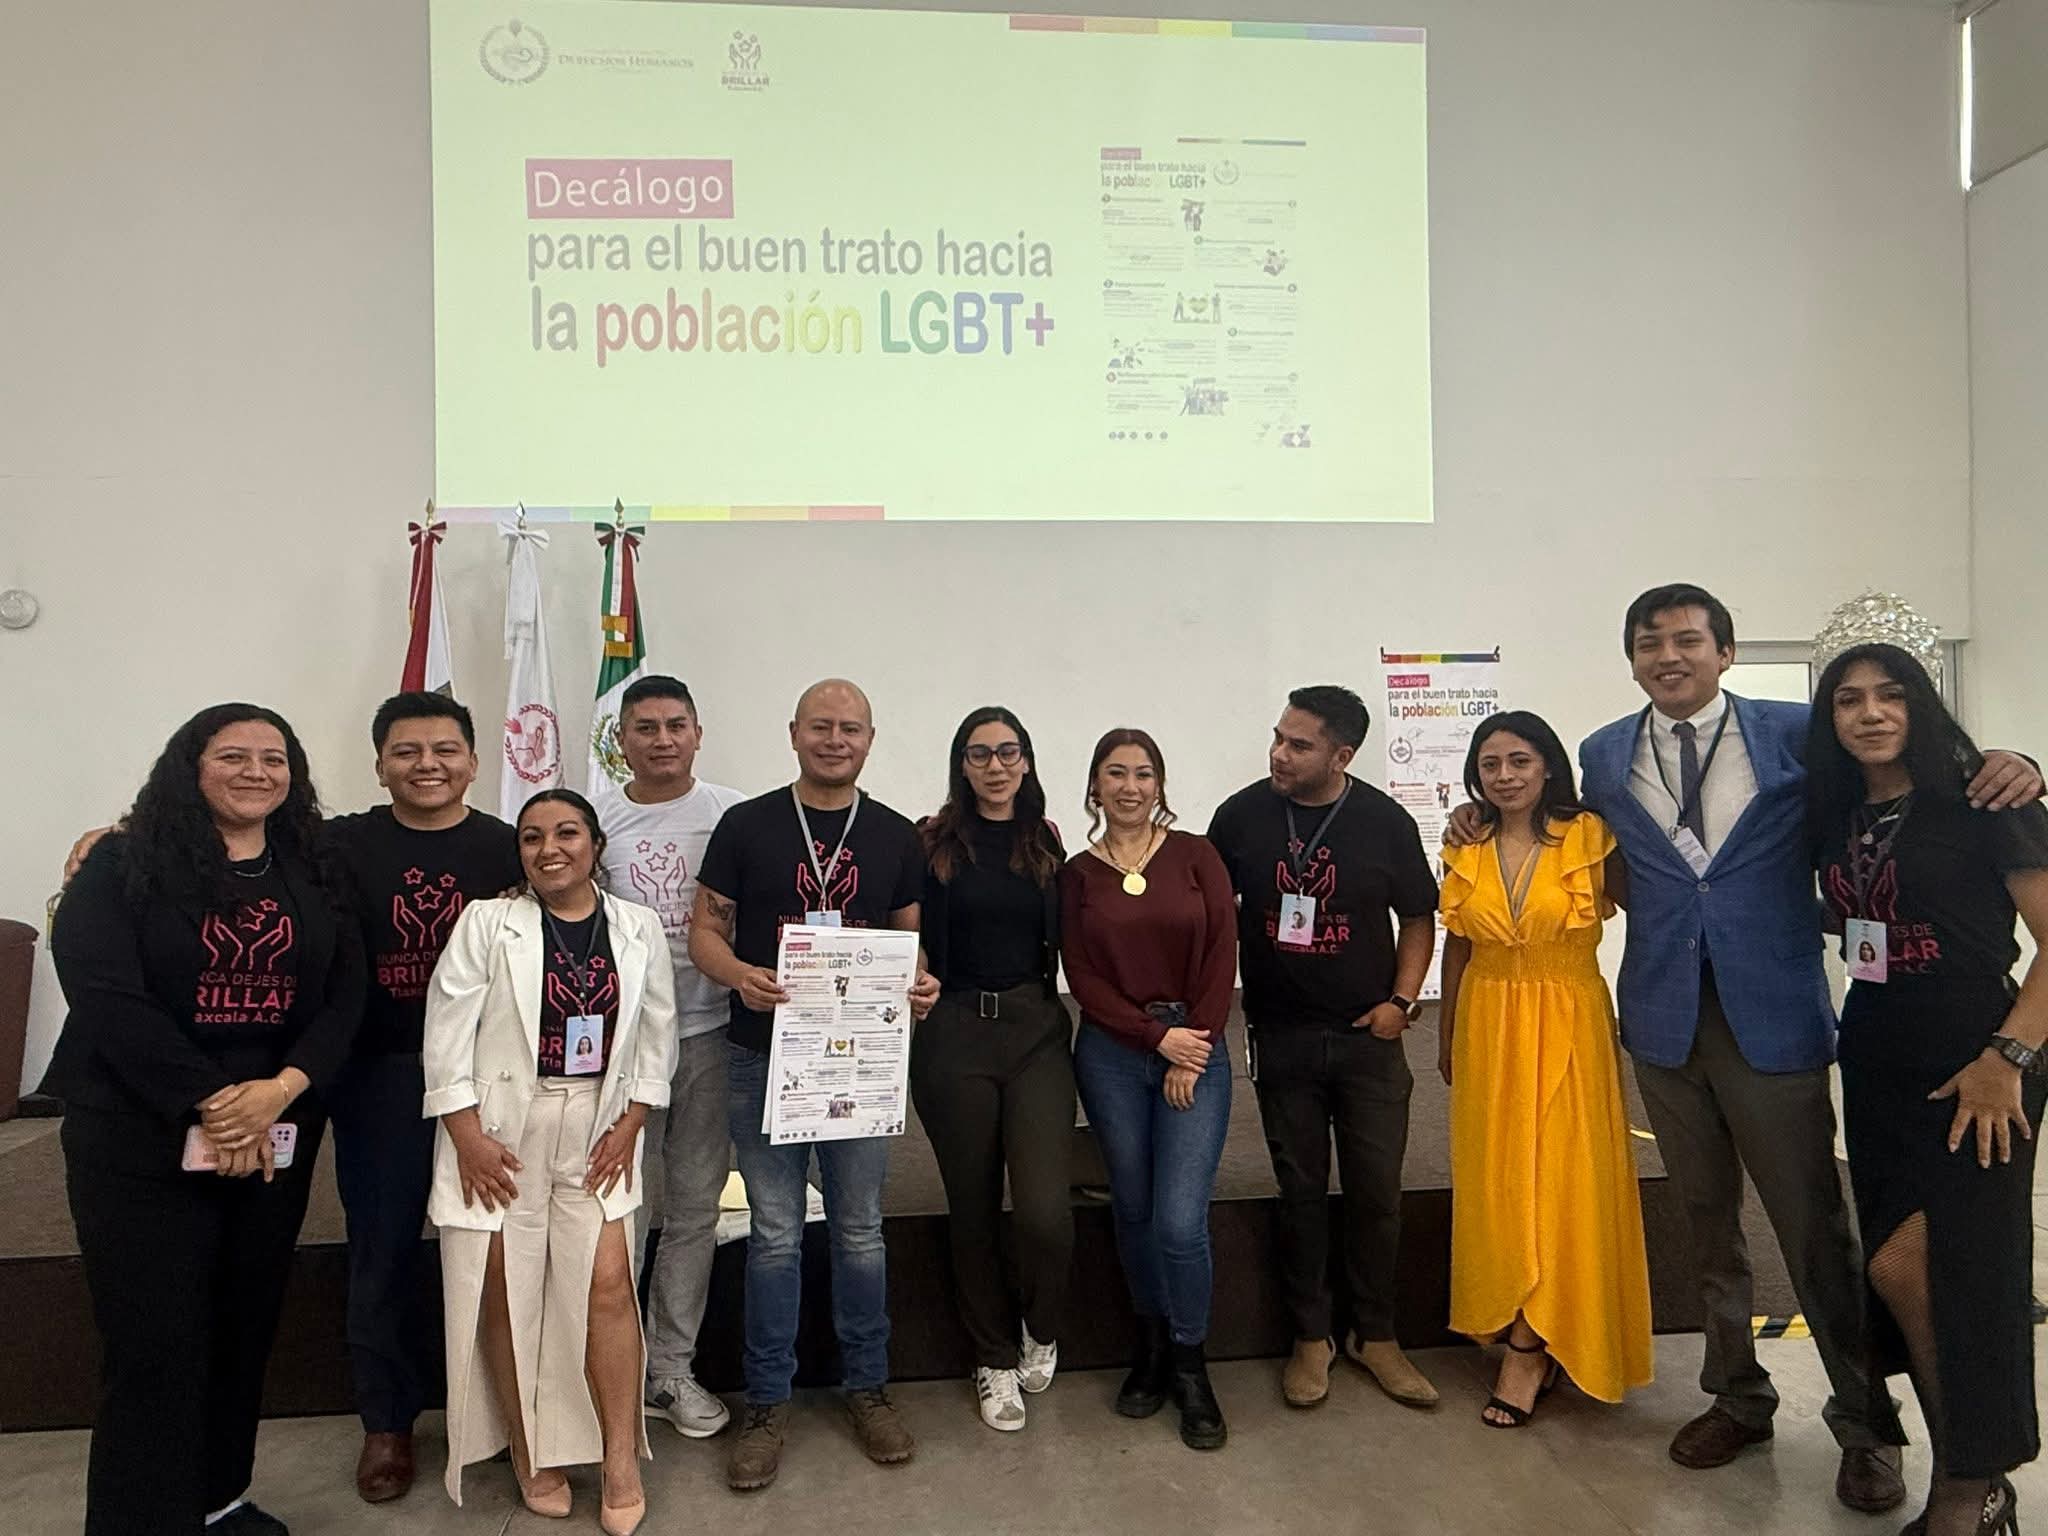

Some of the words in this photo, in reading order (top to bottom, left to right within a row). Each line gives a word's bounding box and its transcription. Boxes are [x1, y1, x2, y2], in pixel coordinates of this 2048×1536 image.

[1169, 174, 1206, 188] LGBT+
[534, 168, 723, 213] Decálogo
[528, 232, 631, 280] para
[645, 225, 682, 271] el
[698, 225, 806, 273] buen
[820, 227, 923, 276] trato
[937, 229, 1054, 277] hacia
[532, 286, 578, 352] la
[597, 287, 863, 368] población
[881, 291, 1054, 355] LGBT+
[1389, 690, 1409, 701] para
[1411, 688, 1420, 699] el
[1422, 688, 1445, 699] buen
[1448, 688, 1470, 699] trato
[1472, 688, 1498, 698] hacia
[1389, 703, 1399, 717] la
[1402, 702, 1458, 720] población
[1461, 701, 1499, 716] LGBT+
[1911, 923, 1936, 937] DE
[232, 973, 280, 987] DEJES
